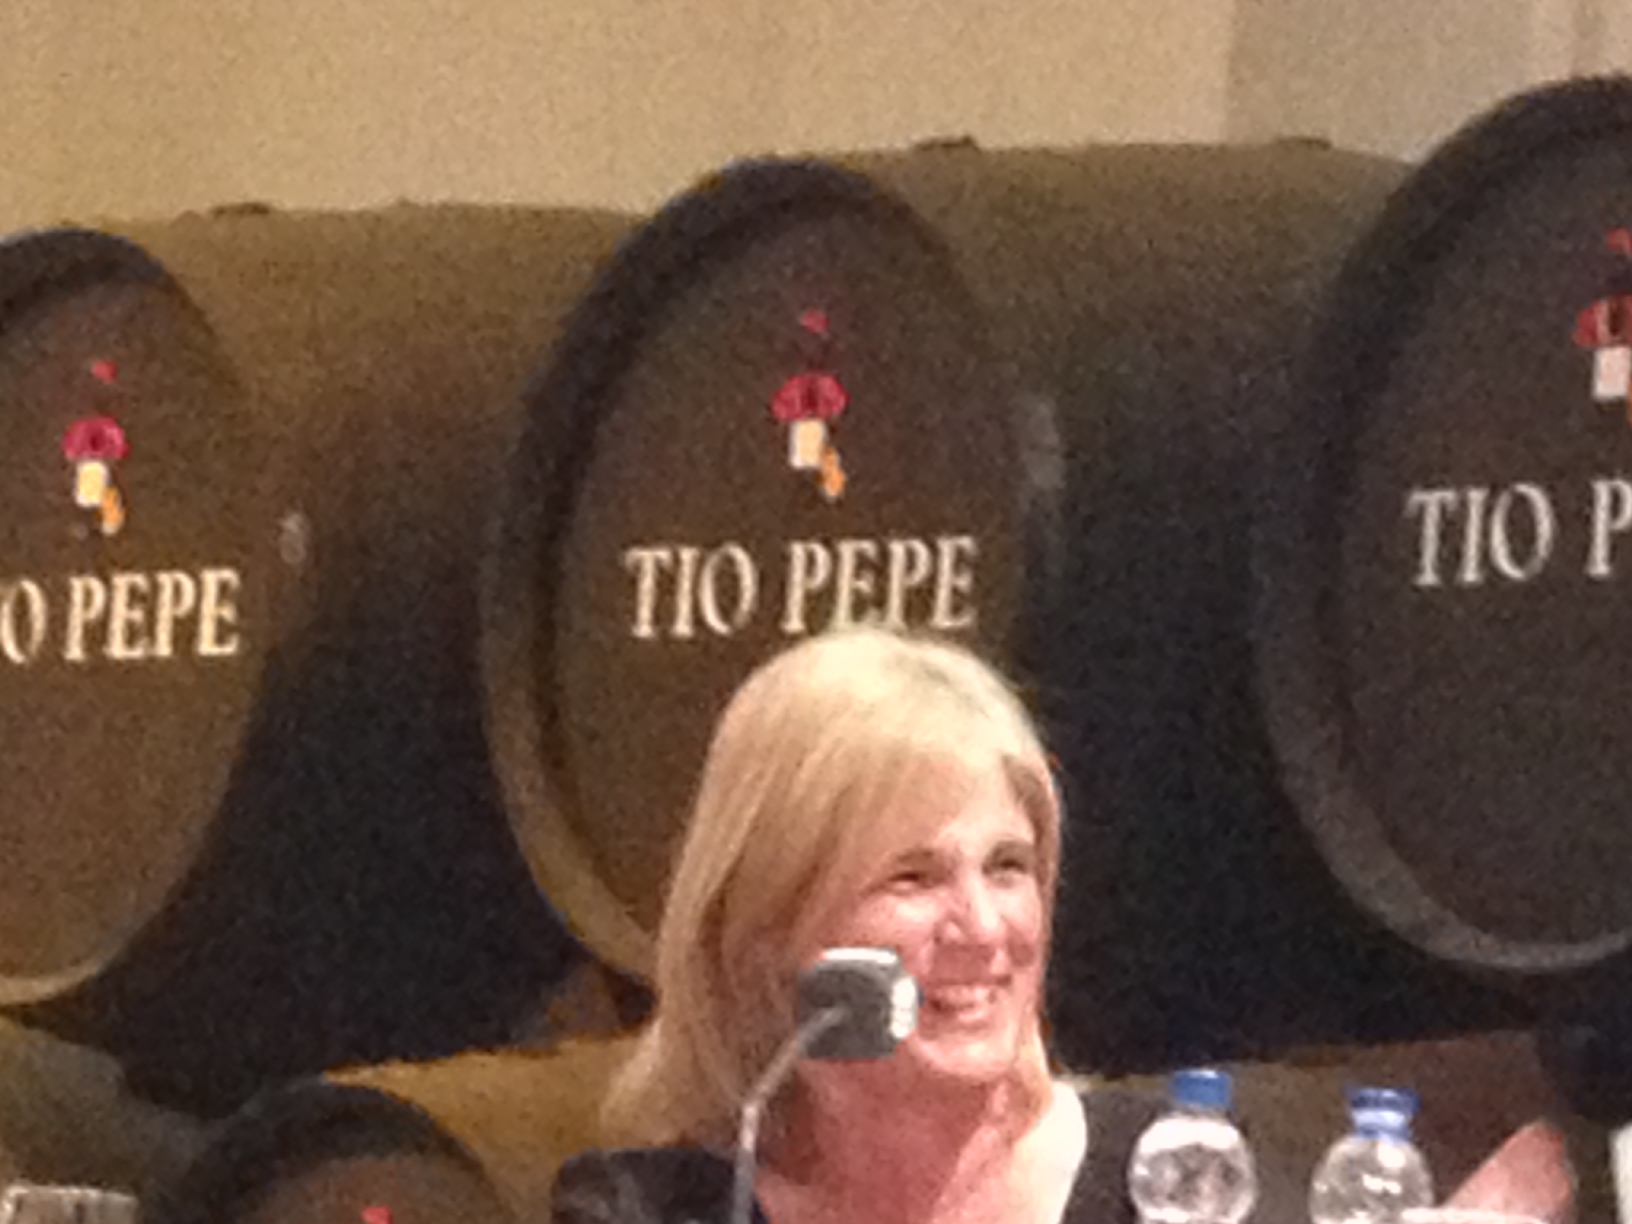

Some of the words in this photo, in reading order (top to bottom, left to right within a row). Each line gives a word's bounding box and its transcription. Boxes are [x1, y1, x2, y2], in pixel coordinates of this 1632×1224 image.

[624, 542, 756, 638] TIO
[780, 535, 976, 634] PEPE
[1404, 483, 1555, 587] TIO
[64, 569, 241, 663] PEPE
